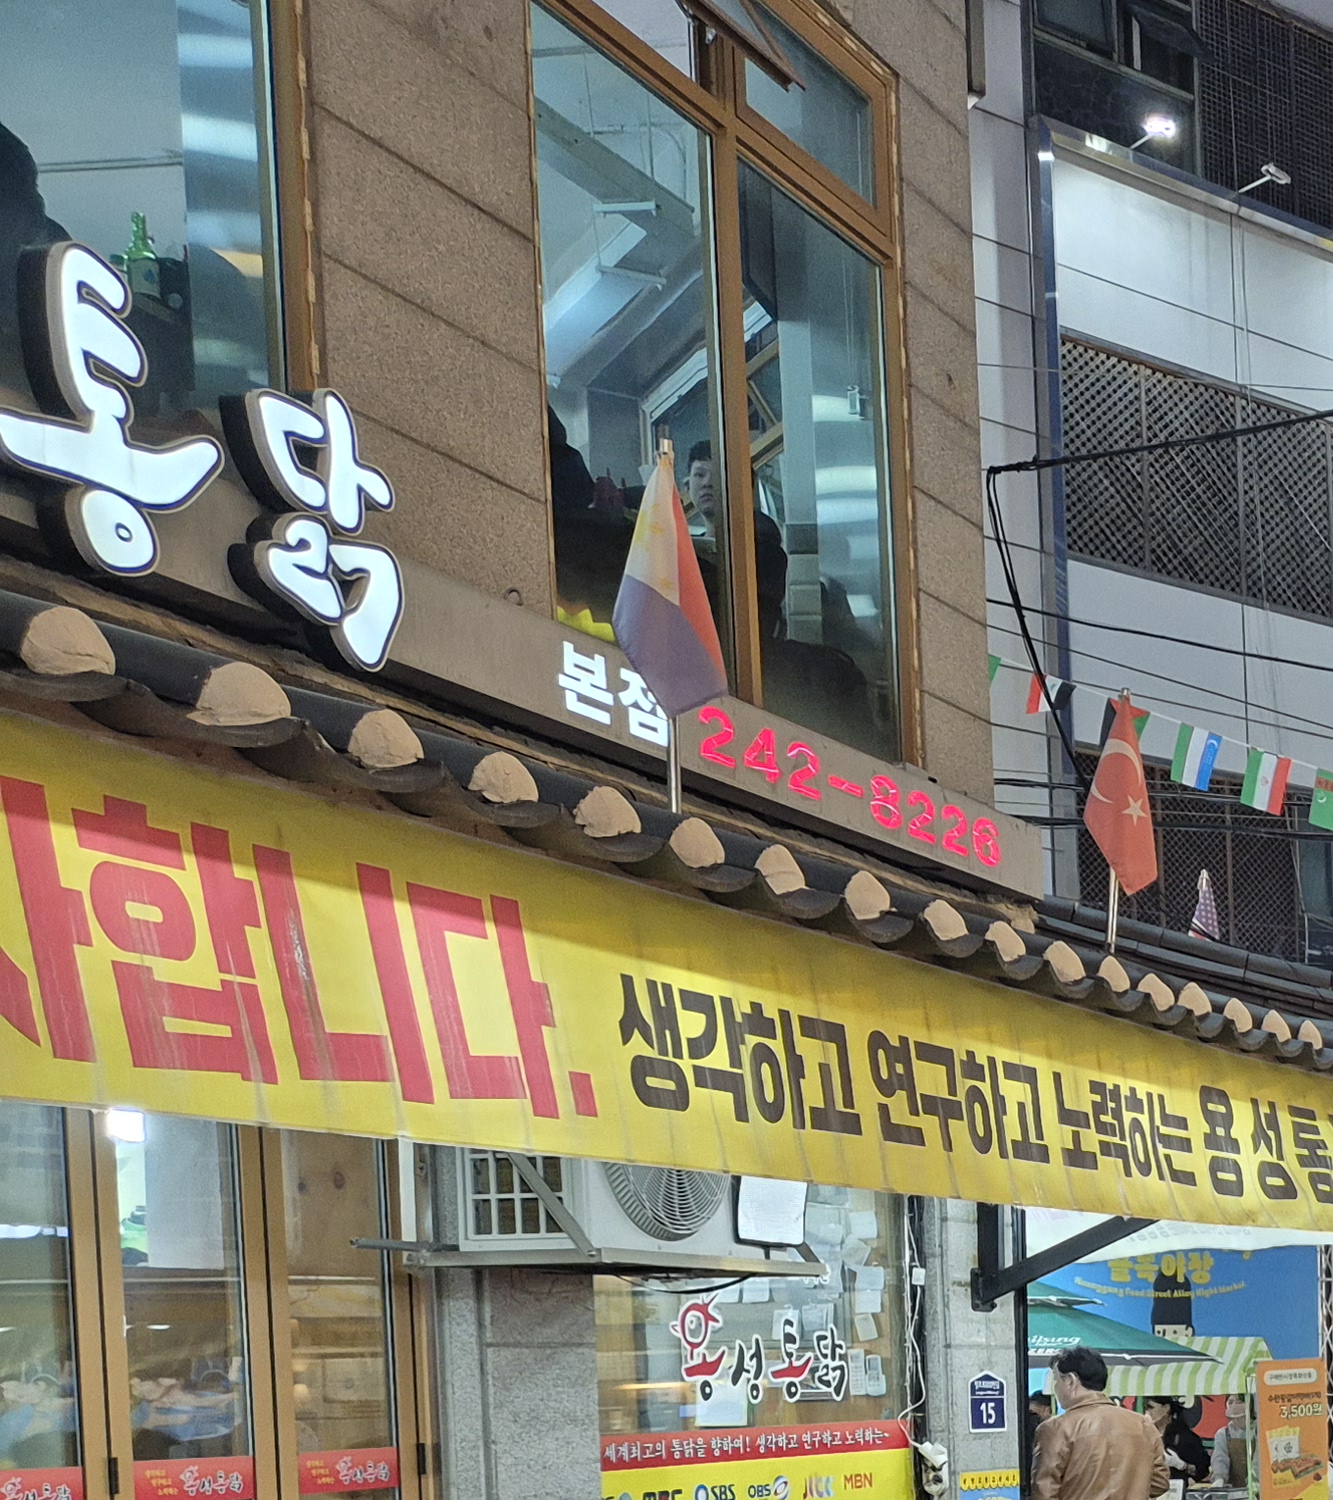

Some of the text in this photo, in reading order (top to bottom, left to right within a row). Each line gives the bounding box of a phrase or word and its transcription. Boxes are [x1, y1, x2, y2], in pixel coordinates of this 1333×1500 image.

[0, 245, 404, 672] 통닭
[699, 705, 1000, 867] 242-8226
[618, 972, 864, 1137] 생각하고
[869, 1029, 1050, 1166] 연구하고
[1052, 1070, 1201, 1188] 노력하는
[671, 1293, 848, 1402] 용성통닭
[603, 1443, 666, 1463] 세계최고의
[670, 1437, 707, 1460] 통닭을
[710, 1433, 751, 1455] 향하여!
[755, 1429, 798, 1454] 생각하고
[801, 1429, 842, 1448] 연구하고
[980, 1402, 996, 1424] 15
[1280, 1403, 1323, 1419] 3,500원
[748, 1483, 771, 1499] OBS
[844, 1472, 873, 1491] MBN
